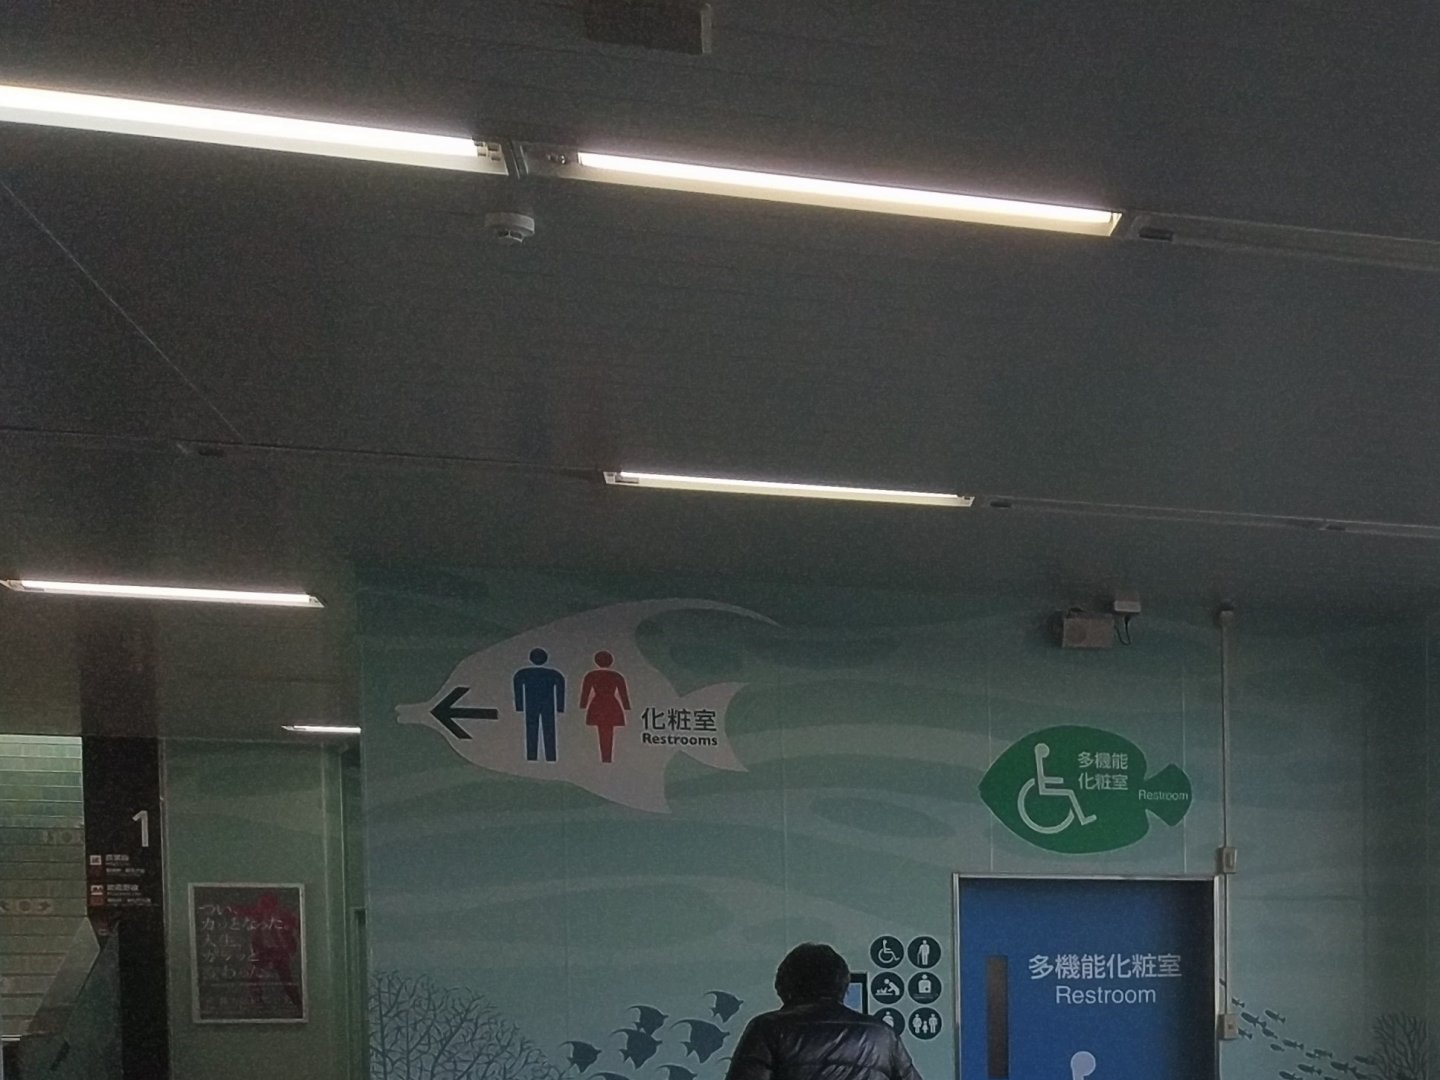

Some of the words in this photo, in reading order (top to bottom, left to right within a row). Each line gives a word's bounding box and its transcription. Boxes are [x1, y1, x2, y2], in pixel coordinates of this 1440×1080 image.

[641, 707, 717, 732] 化粧室
[642, 733, 718, 746] Restrooms
[1077, 751, 1129, 770] 多機能
[1078, 772, 1129, 791] 化粧室
[1138, 789, 1189, 801] Restroom
[131, 809, 150, 848] 1
[1028, 953, 1183, 980] 多機能化粧室
[1055, 985, 1156, 1005] Restroom
